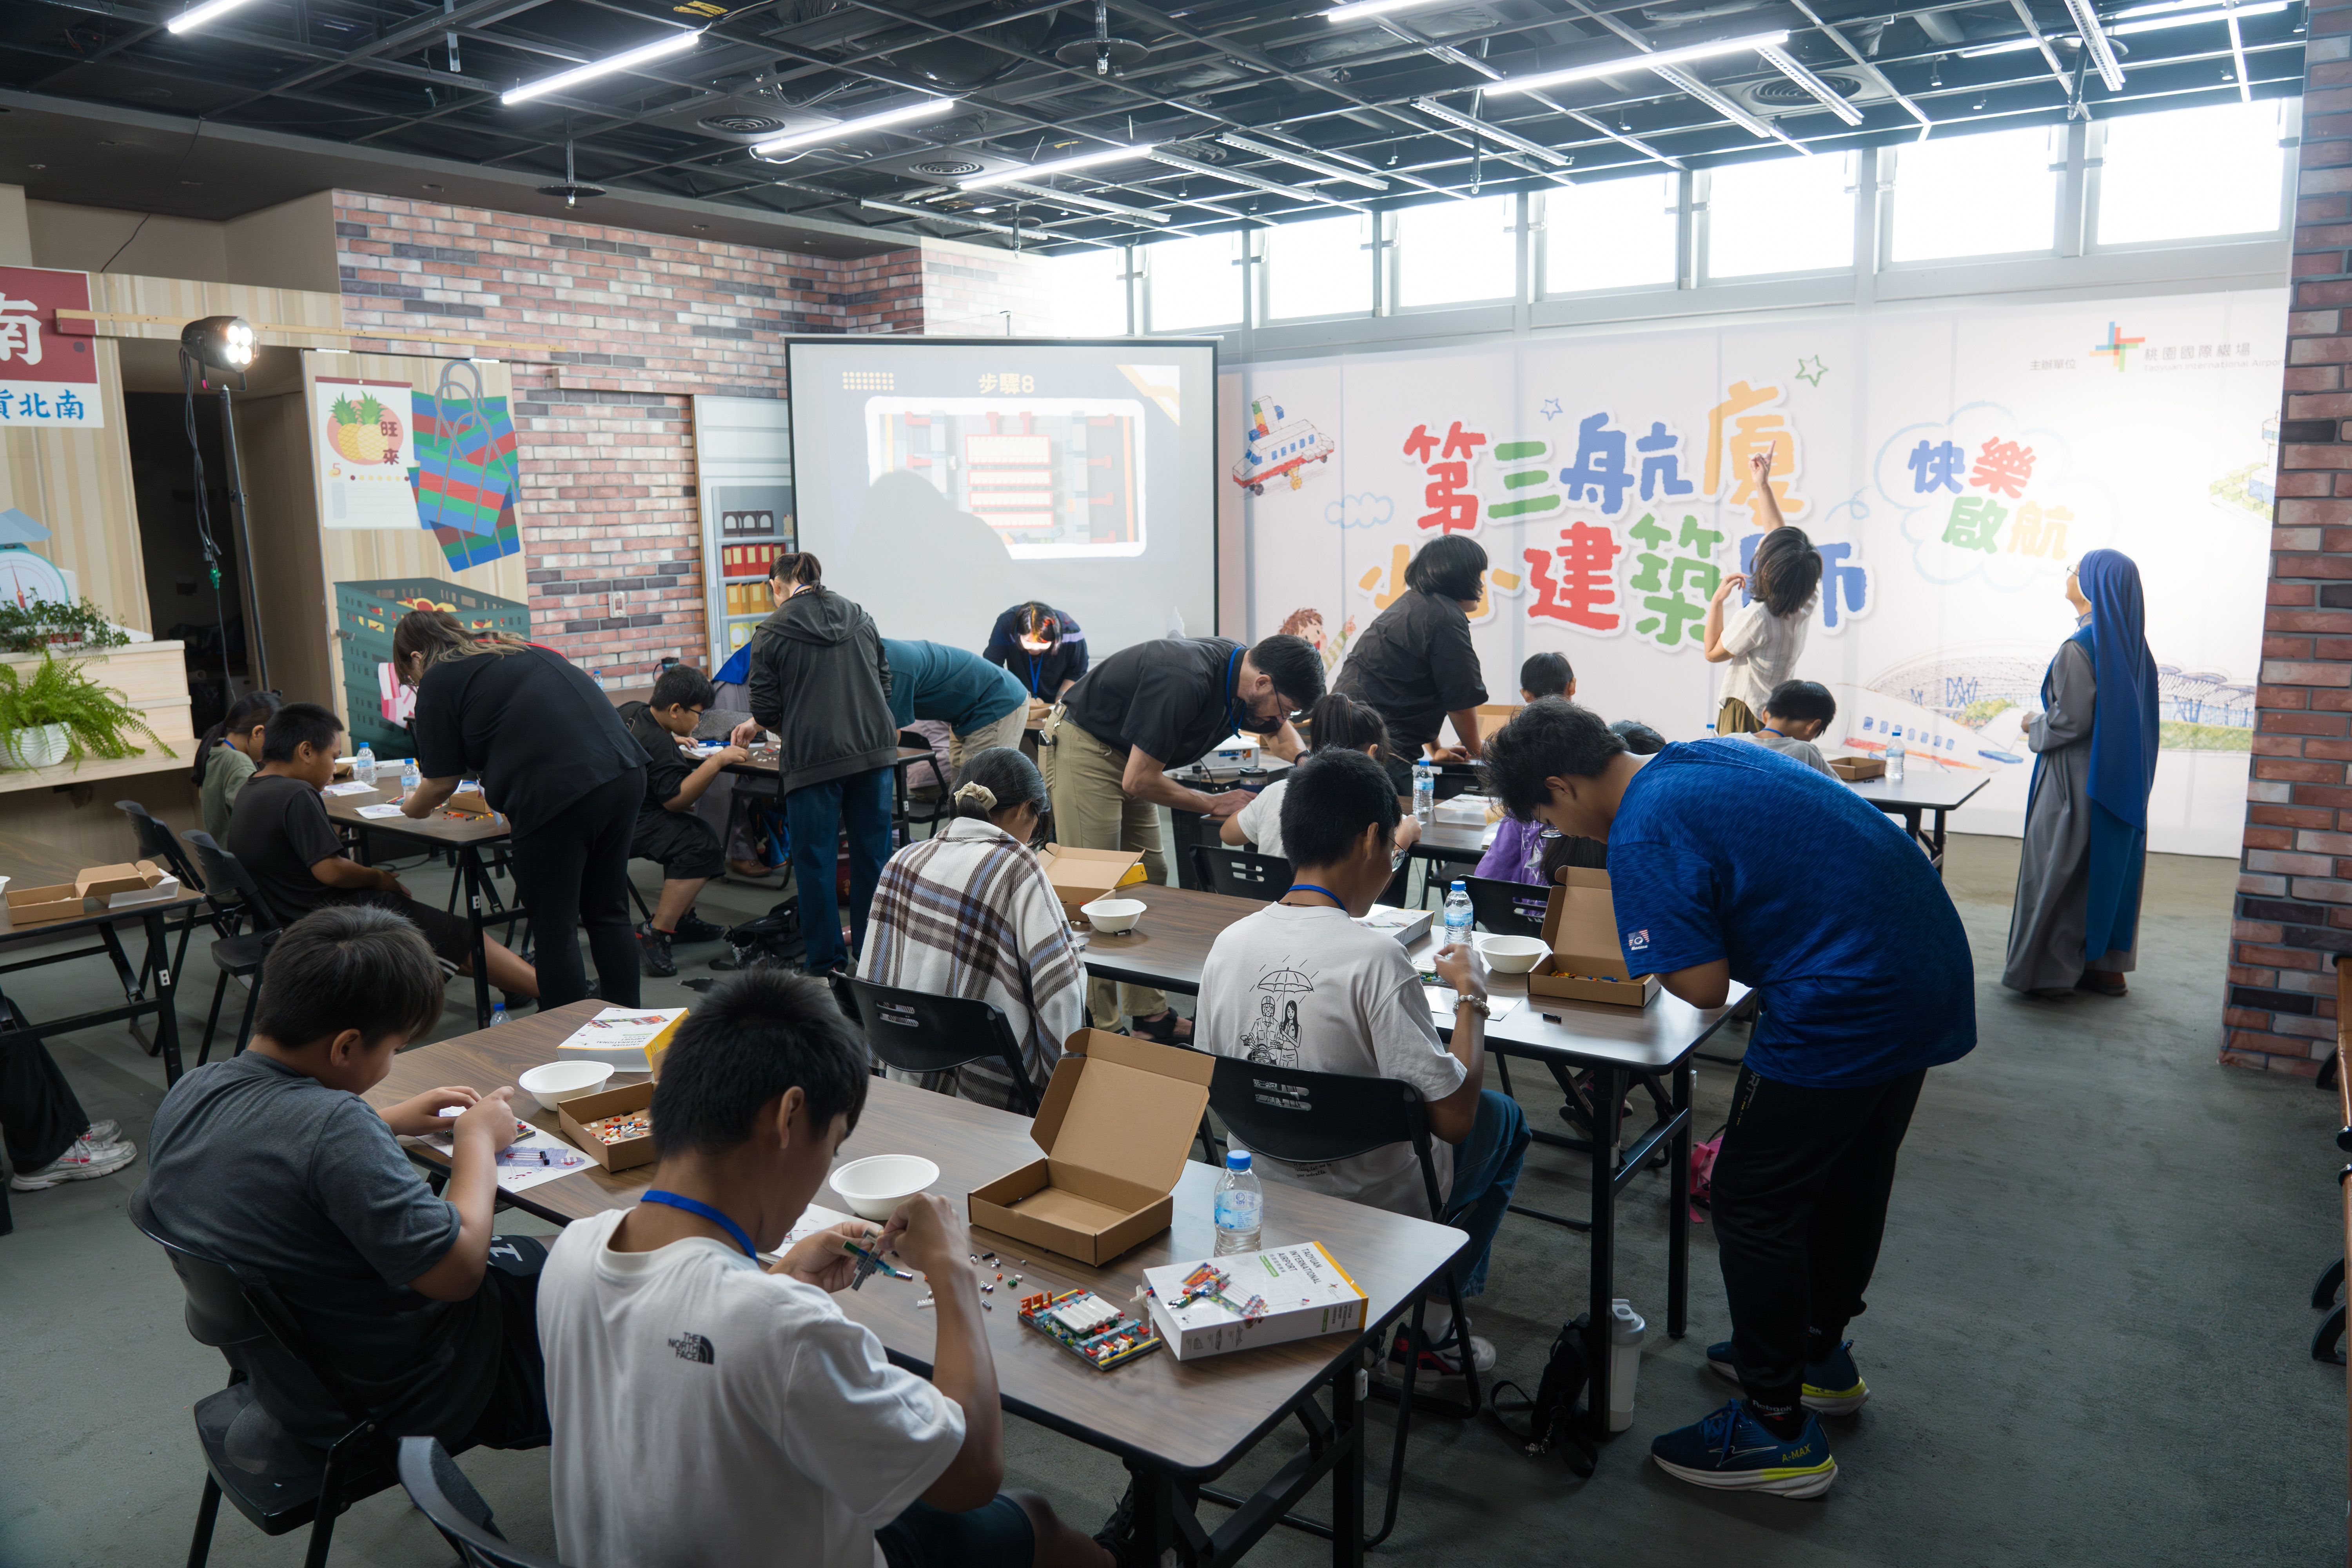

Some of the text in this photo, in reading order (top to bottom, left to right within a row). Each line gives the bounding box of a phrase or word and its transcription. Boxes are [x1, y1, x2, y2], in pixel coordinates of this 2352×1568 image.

[2144, 342, 2250, 361] 桃園國際機場
[2143, 358, 2283, 373] Taoyuan International Airpor
[978, 372, 1034, 394] 步驟8
[1403, 380, 1804, 535] 第三航廈
[332, 463, 341, 475] 5
[1907, 437, 2036, 499] 快樂
[1941, 497, 2074, 560] 啟航
[1277, 1252, 1298, 1271] AIRPORT
[1289, 1250, 1321, 1284] INTERNATIONAL
[1301, 1248, 1323, 1268] TAOYUAN
[668, 1338, 699, 1352] NORTH
[684, 1332, 700, 1343] THE
[676, 1348, 699, 1361] FACE
[1782, 1443, 1813, 1463] A-MAX
